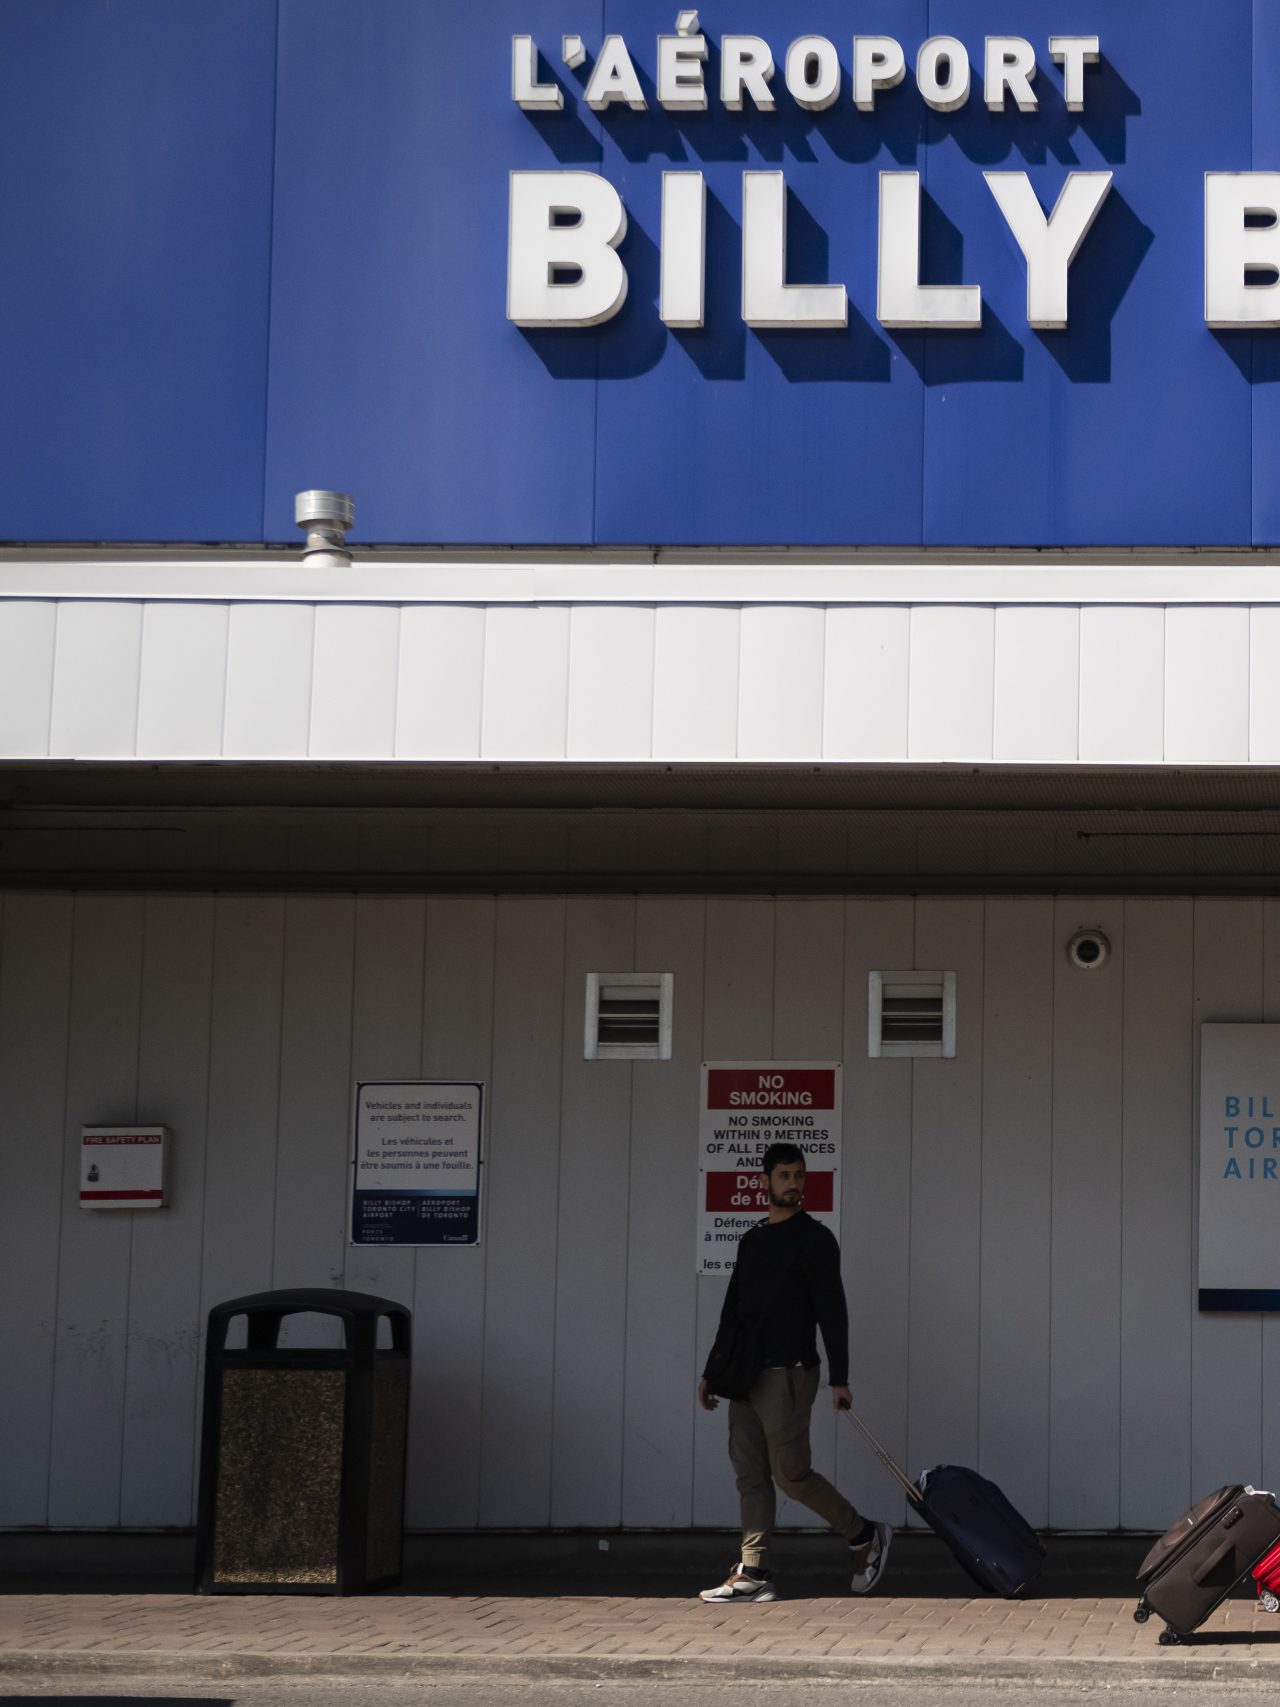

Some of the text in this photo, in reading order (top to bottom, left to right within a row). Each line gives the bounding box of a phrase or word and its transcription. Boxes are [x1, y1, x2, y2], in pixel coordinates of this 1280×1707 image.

[511, 9, 1100, 112] L'AÉROPORT
[505, 169, 1114, 329] BILLY
[758, 1075, 784, 1089] NO
[729, 1092, 813, 1106] SMOKING
[365, 1102, 472, 1110] Vehicles and individuals
[387, 1114, 420, 1123] subject
[433, 1114, 466, 1122] search.
[728, 1116, 814, 1126] NO SMOKING
[105, 1136, 136, 1144] SAFETY
[137, 1136, 160, 1144] PLAN
[714, 1130, 829, 1140] WITHIN 9 METRES
[400, 1137, 442, 1146] véhicules
[444, 1138, 454, 1146] et
[706, 1144, 725, 1154] OF
[728, 1144, 752, 1154] ALL
[367, 1150, 468, 1159] les personnes peuvent
[360, 1161, 379, 1169] être
[381, 1161, 413, 1169] soumis
[415, 1161, 421, 1169] à
[736, 1157, 764, 1167] AND
[730, 1193, 751, 1205] de
[704, 1231, 712, 1242] à
[703, 1259, 721, 1269] les
